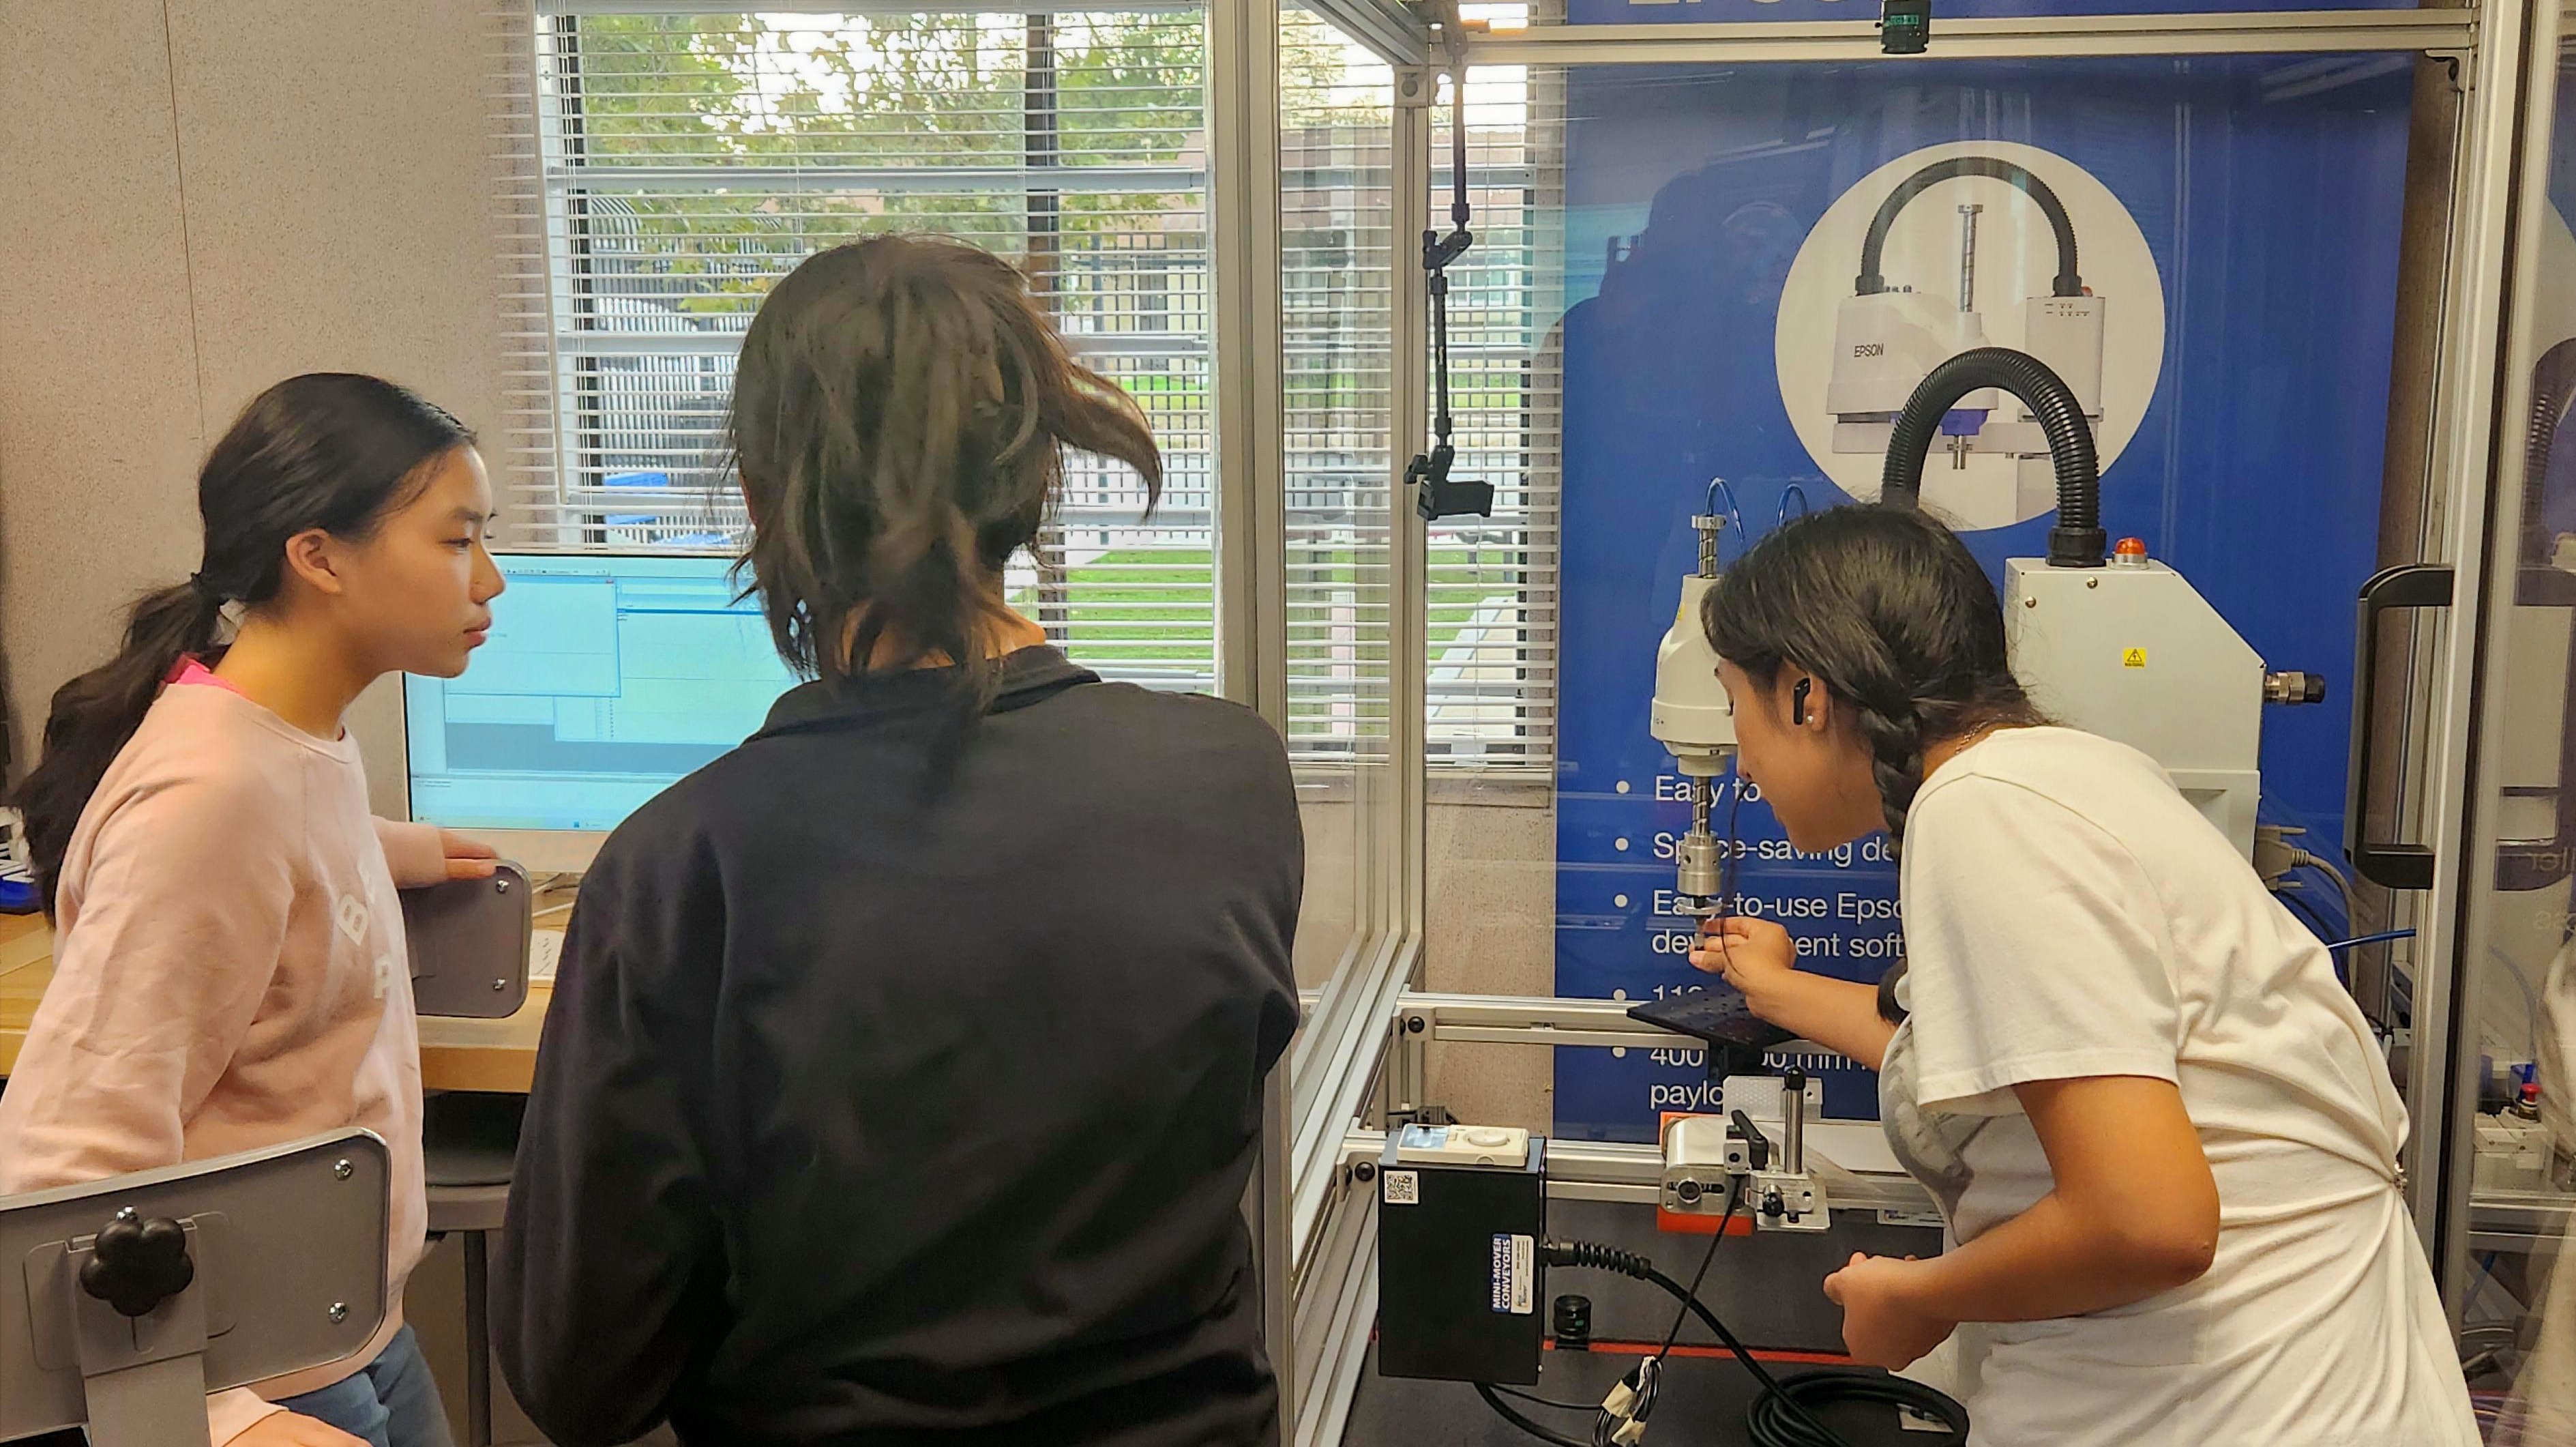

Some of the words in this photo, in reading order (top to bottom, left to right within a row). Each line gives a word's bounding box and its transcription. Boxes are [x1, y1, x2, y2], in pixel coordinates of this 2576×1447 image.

[1854, 343, 1884, 357] EPSON
[1655, 775, 1725, 808] Eay
[1732, 777, 1762, 802] to
[1653, 832, 1852, 868] Sce-sag
[1653, 890, 1829, 922] Ea-to-use
[1493, 1238, 1502, 1309] MINI-MOVER
[1501, 1239, 1511, 1309] CONVEYORS
